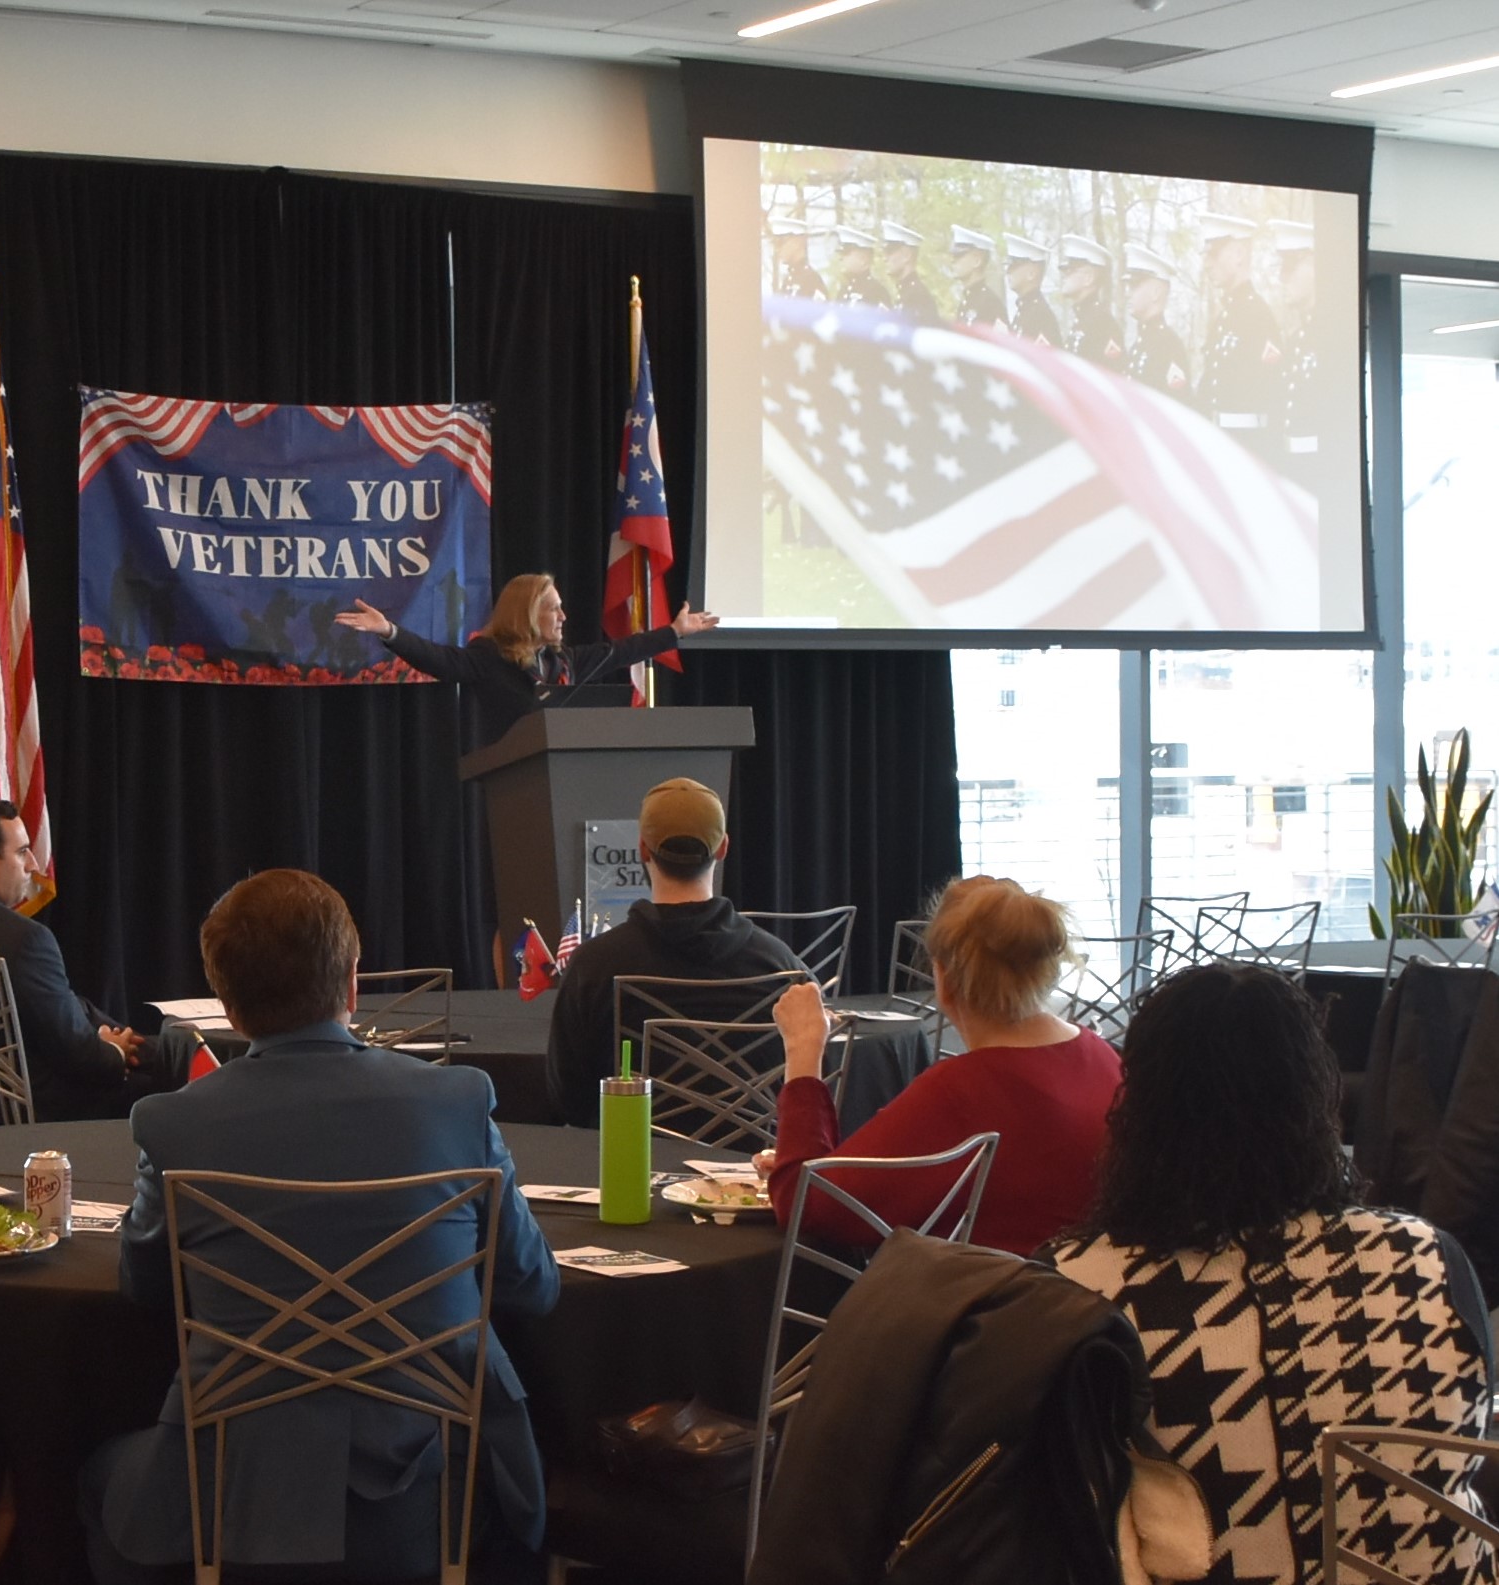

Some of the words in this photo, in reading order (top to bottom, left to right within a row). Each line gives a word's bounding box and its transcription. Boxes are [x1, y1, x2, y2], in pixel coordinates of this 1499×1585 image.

[136, 469, 311, 520] THANK
[347, 479, 443, 522] YOU
[156, 526, 430, 579] VETERANS
